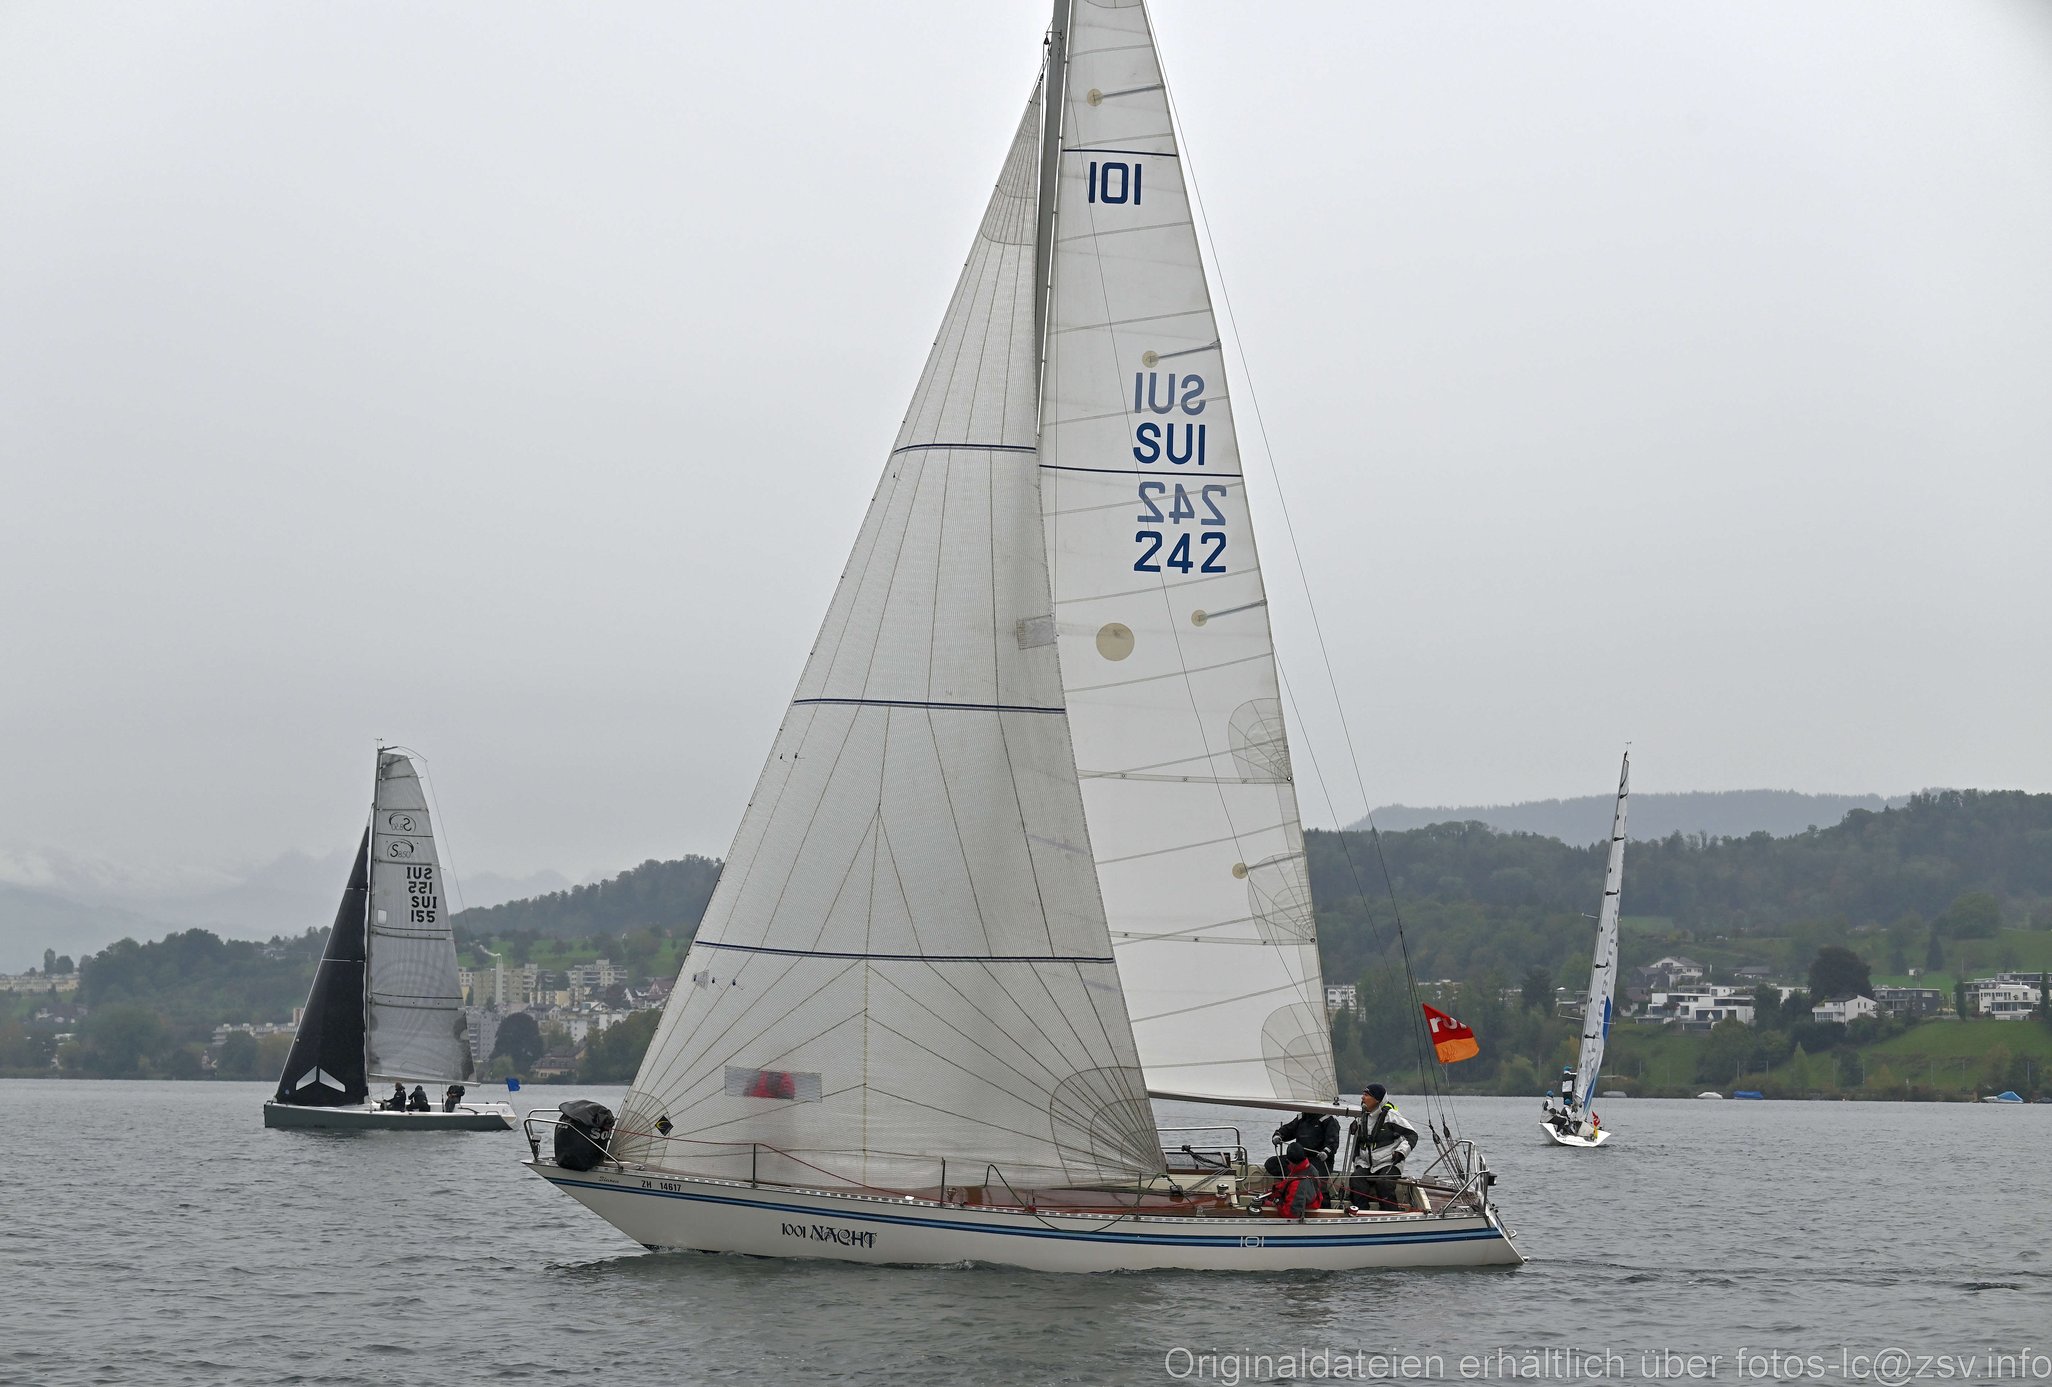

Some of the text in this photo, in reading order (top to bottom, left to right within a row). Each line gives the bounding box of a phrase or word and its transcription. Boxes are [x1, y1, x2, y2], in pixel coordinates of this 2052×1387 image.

[1132, 421, 1206, 466] SUI
[1133, 530, 1228, 575] 242
[411, 896, 437, 909] SUI
[411, 910, 436, 923] 155
[641, 1180, 652, 1189] ZH
[810, 1224, 878, 1249] NACHT
